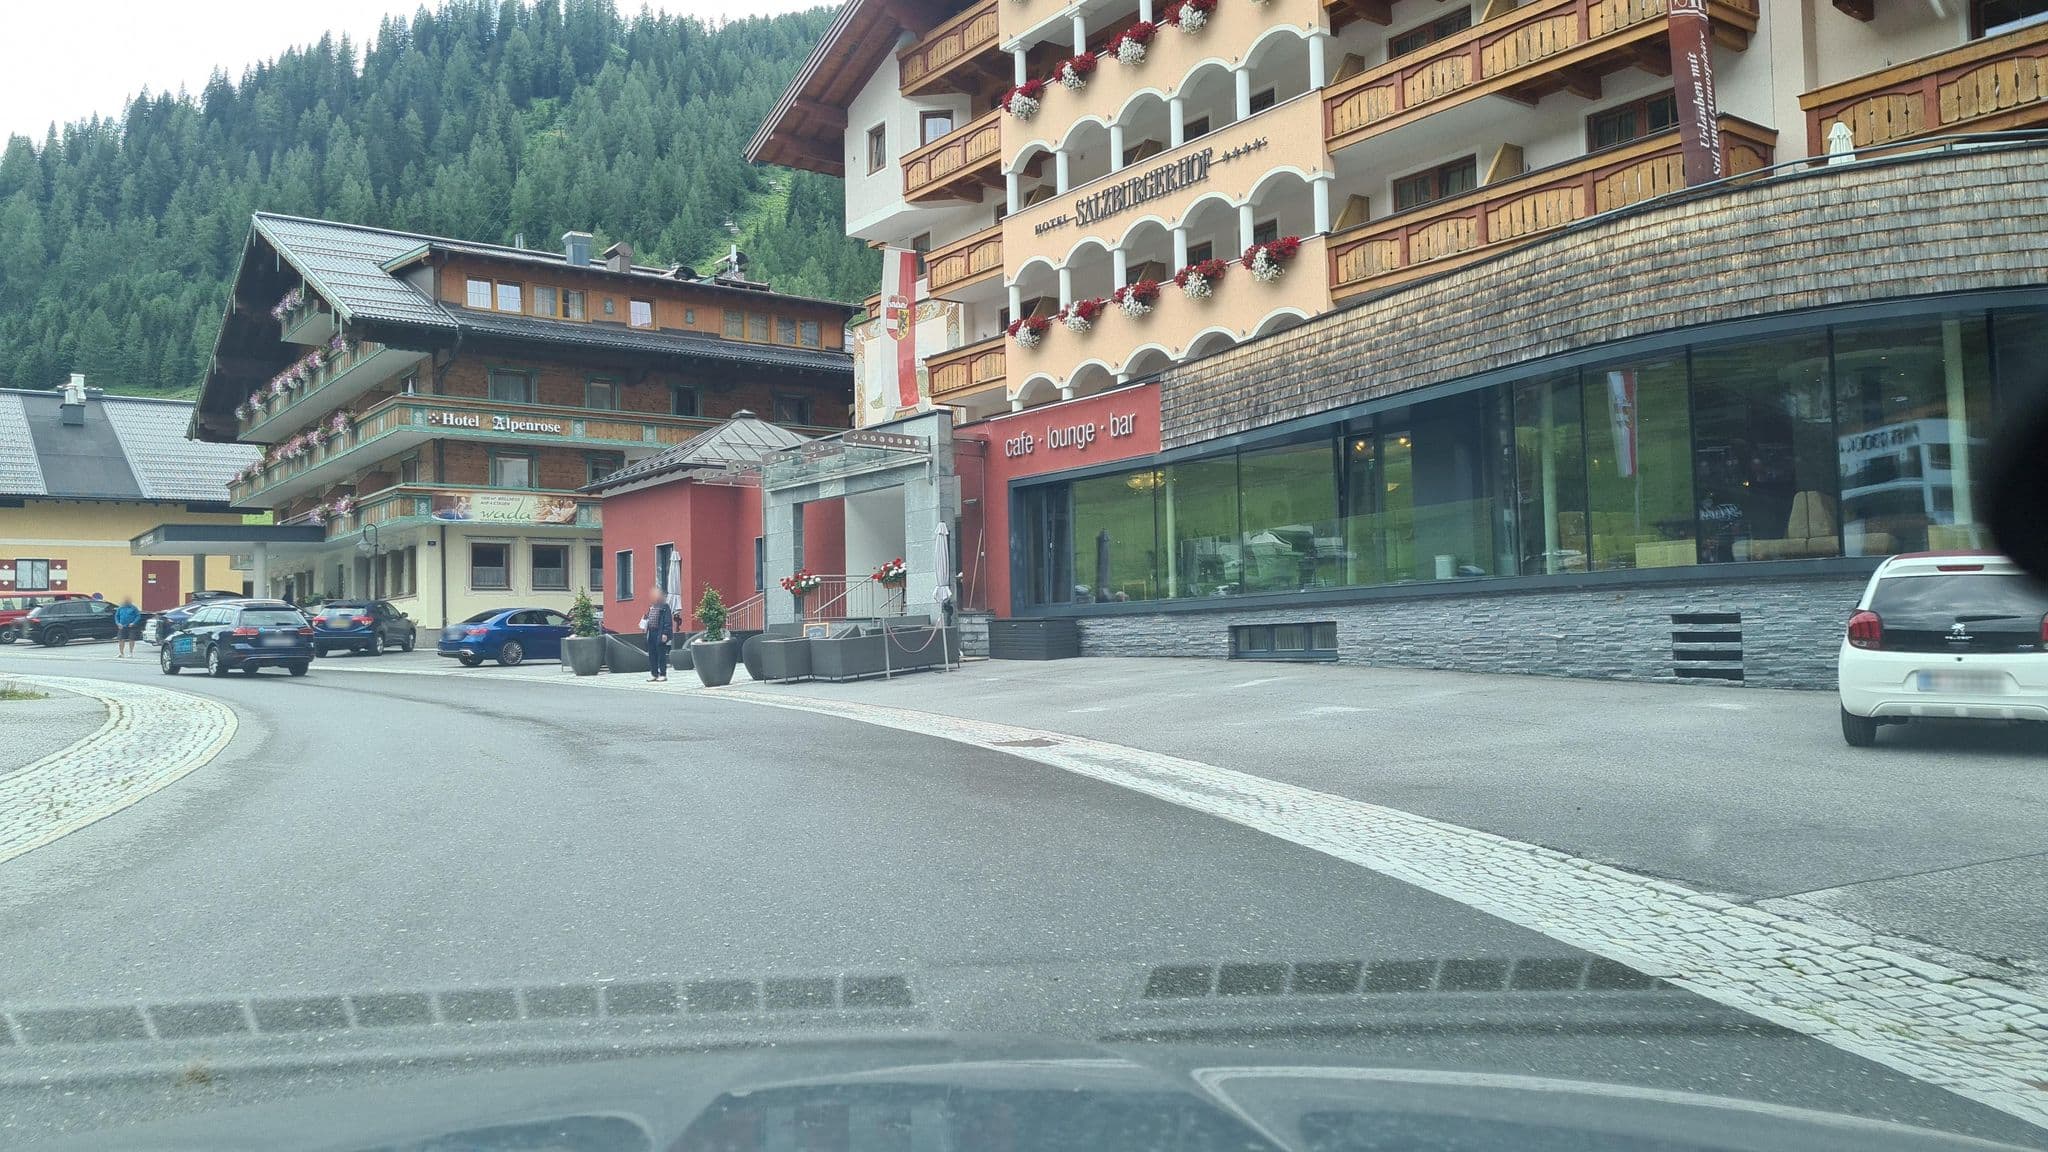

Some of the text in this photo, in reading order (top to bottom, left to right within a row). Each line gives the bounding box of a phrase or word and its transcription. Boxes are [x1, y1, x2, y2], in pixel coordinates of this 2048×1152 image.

[1687, 51, 1710, 149] Urlauben mit
[1708, 116, 1719, 148] und
[1712, 150, 1721, 176] Stil
[1034, 213, 1070, 236] HOTEL
[1075, 146, 1213, 227] SALZBURGERHOF
[442, 412, 561, 433] Hotel Alpenrose
[1005, 411, 1136, 457] cafe lounge bar
